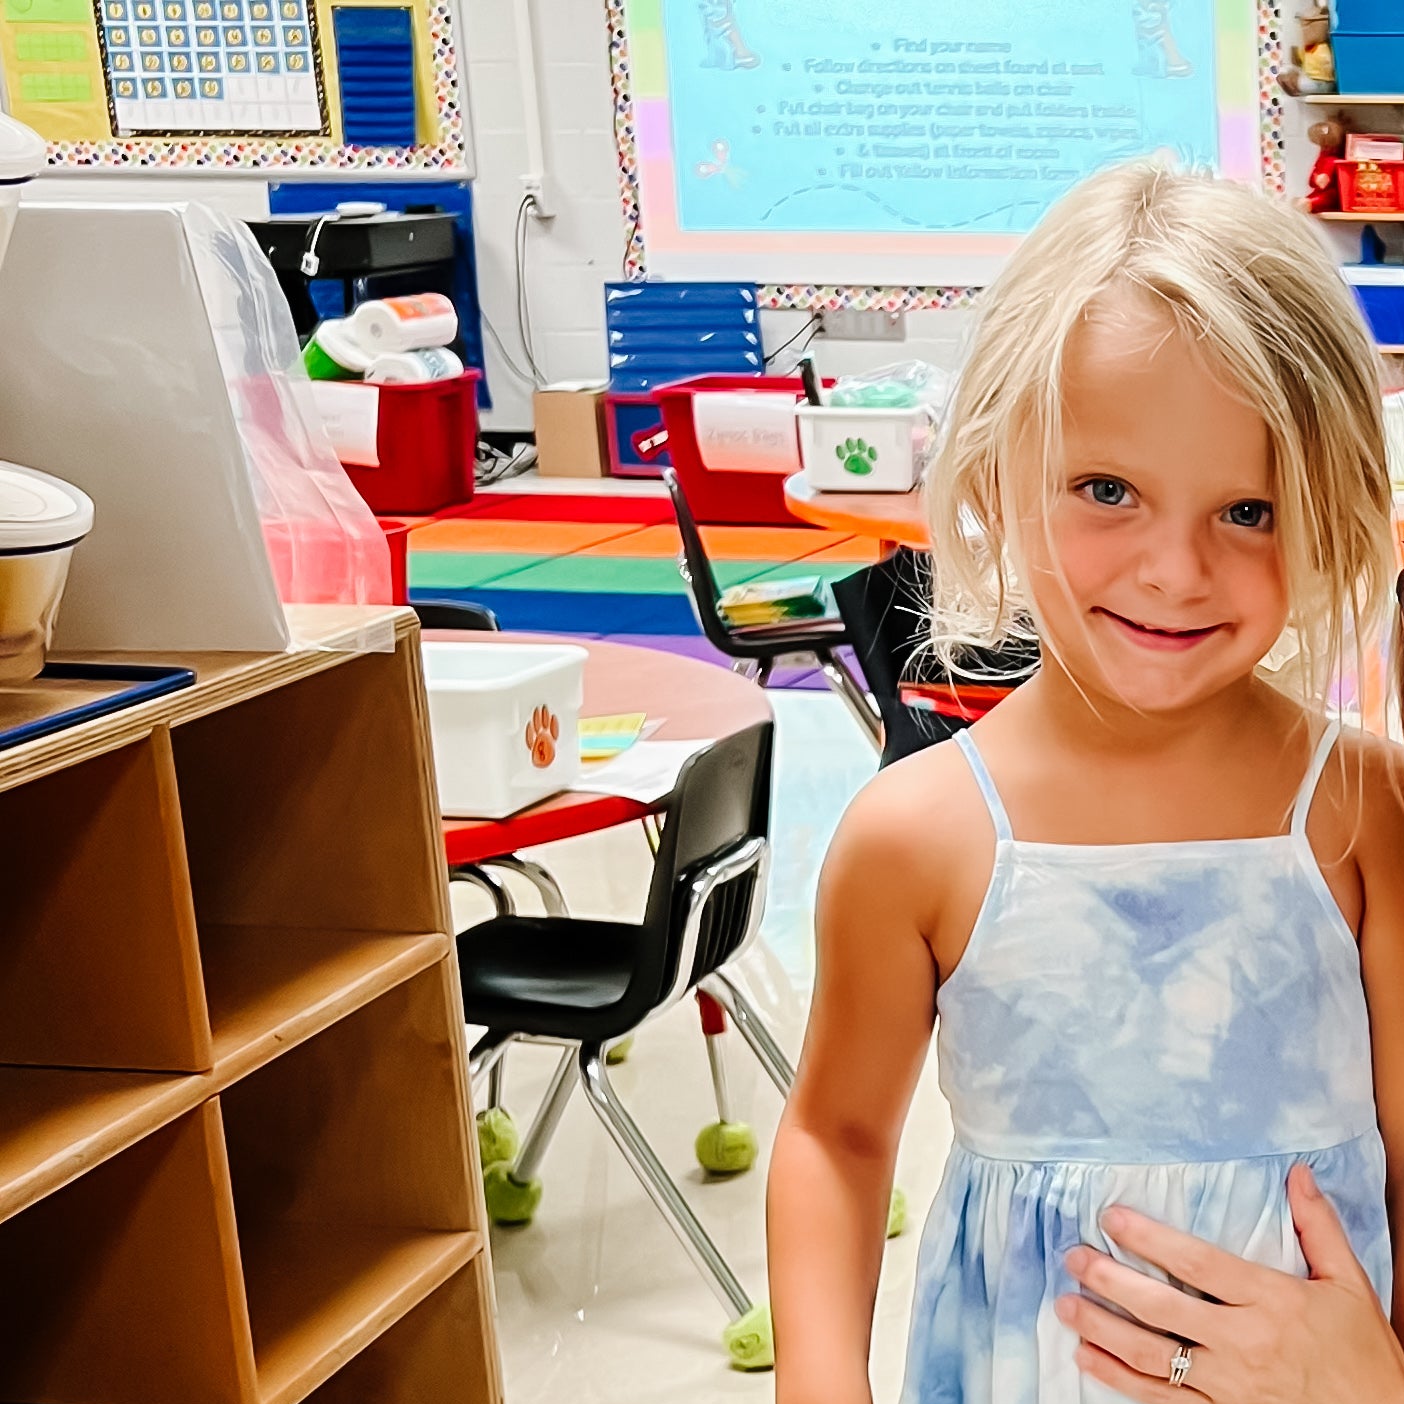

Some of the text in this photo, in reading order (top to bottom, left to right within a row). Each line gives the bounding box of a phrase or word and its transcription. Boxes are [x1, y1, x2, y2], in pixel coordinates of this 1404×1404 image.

[893, 38, 927, 53] Find
[930, 42, 964, 56] your
[804, 58, 855, 74] Follow
[934, 62, 956, 74] on
[1013, 84, 1034, 96] on
[777, 101, 804, 116] Put
[876, 104, 898, 116] on
[773, 121, 801, 136] Put
[537, 741, 546, 762] 8
